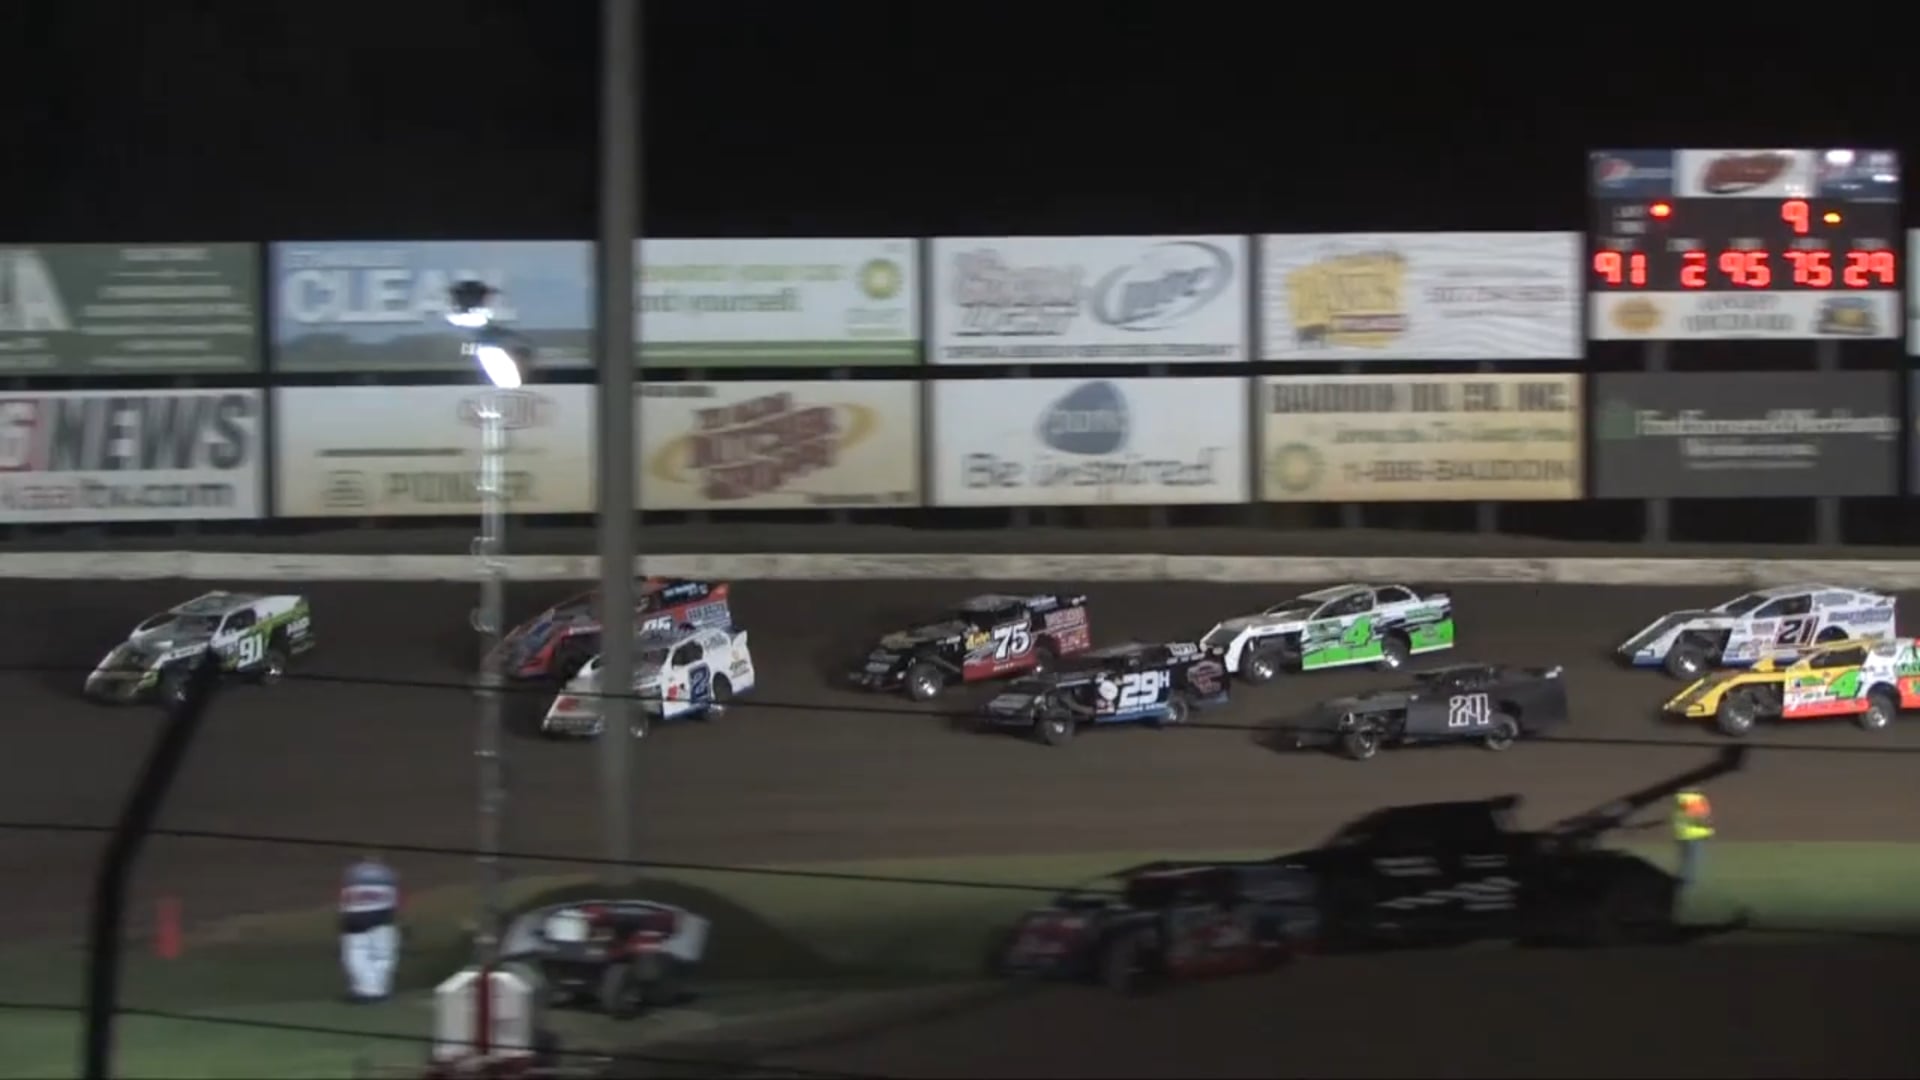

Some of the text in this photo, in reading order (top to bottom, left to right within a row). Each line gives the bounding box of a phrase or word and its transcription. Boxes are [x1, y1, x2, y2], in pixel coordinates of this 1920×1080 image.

[1781, 200, 1809, 234] 9
[1593, 252, 1646, 285] 91
[1680, 252, 1707, 287] 2
[1718, 252, 1771, 287] 95
[1783, 252, 1833, 287] 75
[1843, 252, 1895, 287] 29
[48, 394, 250, 472] NEWS
[993, 620, 1031, 662] 75
[1341, 614, 1371, 647] 4
[1776, 616, 1818, 648] 21
[237, 633, 264, 669] 91
[690, 663, 711, 701] 2
[1448, 693, 1490, 727] 24
